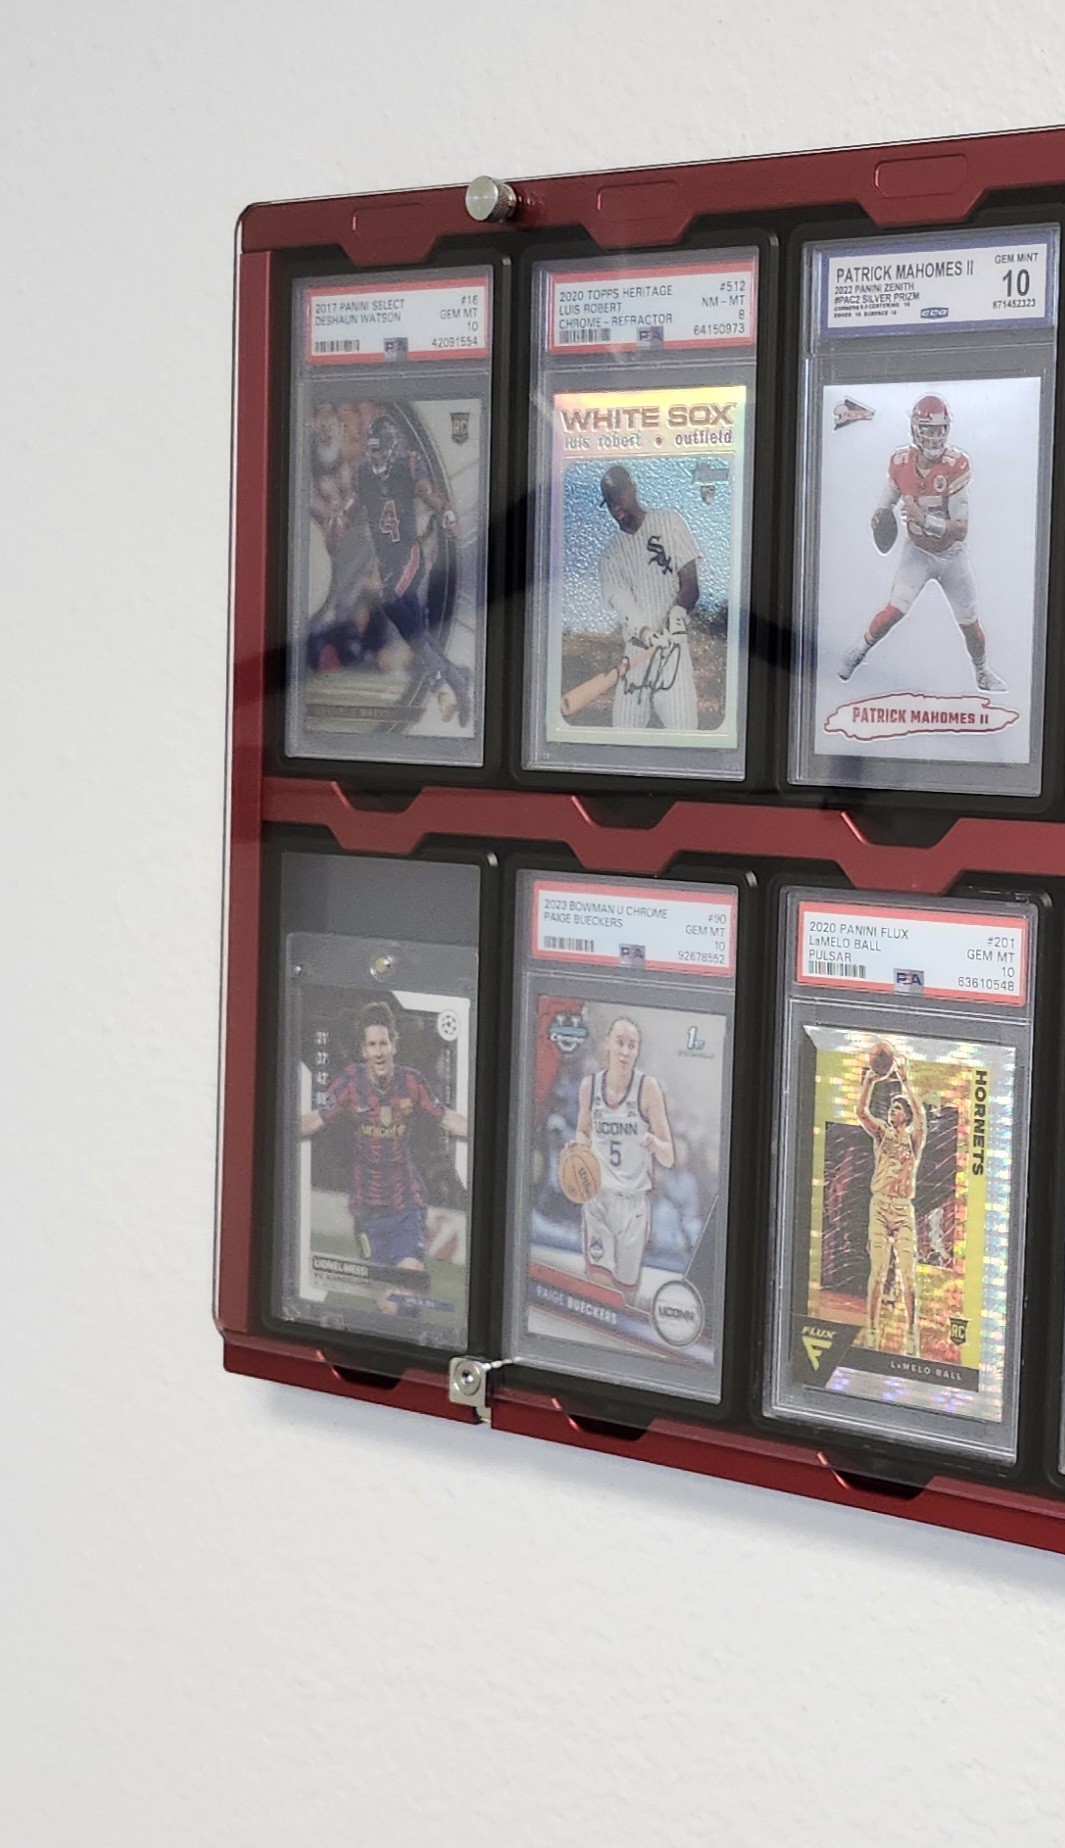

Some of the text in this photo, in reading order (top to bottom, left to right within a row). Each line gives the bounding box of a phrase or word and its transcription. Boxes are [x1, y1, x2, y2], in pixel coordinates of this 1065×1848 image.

[994, 252, 1039, 264] GEM MINT
[836, 260, 974, 284] PATRICK MAHOMES II
[720, 281, 746, 292] #512
[834, 282, 914, 295] 2022 PANINI ZENITH
[1002, 268, 1030, 298] 10
[560, 285, 673, 302] 2020 TOPPS HERITAGE
[862, 294, 892, 304] SILVER
[894, 292, 920, 301] PRIZM
[316, 299, 405, 314] 2017 PANINI SELECT
[559, 302, 622, 316] LUIS ROBERT
[992, 298, 1036, 310] 871452323
[316, 312, 400, 326] DESHAUN WATSON
[440, 308, 478, 320] GEM MT
[739, 310, 746, 320] 8
[468, 322, 478, 332] 10
[559, 314, 673, 330] CHROME REFRACTOR
[694, 323, 746, 336] 64150973
[562, 402, 734, 432] WHITE SOX
[566, 428, 732, 450] luis robert outfield
[379, 500, 400, 542] 4
[853, 707, 988, 724] PATRICK MAHOMES II
[544, 898, 668, 919] 2023 BOWMAN U CHROME
[544, 913, 623, 928] PAIGE BUECKERS
[708, 914, 726, 924] #90
[686, 924, 726, 937] GEM MT
[810, 921, 909, 940] 2020 PANINI FLUX
[714, 941, 725, 951] 10
[809, 936, 882, 951] LaMELO BALL
[988, 936, 1014, 948] #201
[678, 951, 725, 964] 92678552
[808, 950, 852, 962] PULSAR
[966, 949, 1015, 963] GEM MT
[1002, 967, 1014, 978] 10
[958, 976, 1014, 992] 63610548
[594, 1121, 638, 1136] UCONN
[972, 1069, 988, 1176] HORNETS
[610, 1142, 622, 1167] 5
[567, 1296, 618, 1326] BUECKERS
[802, 1326, 837, 1340] FLUX
[952, 1322, 966, 1340] RC
[936, 1369, 962, 1381] BALL
